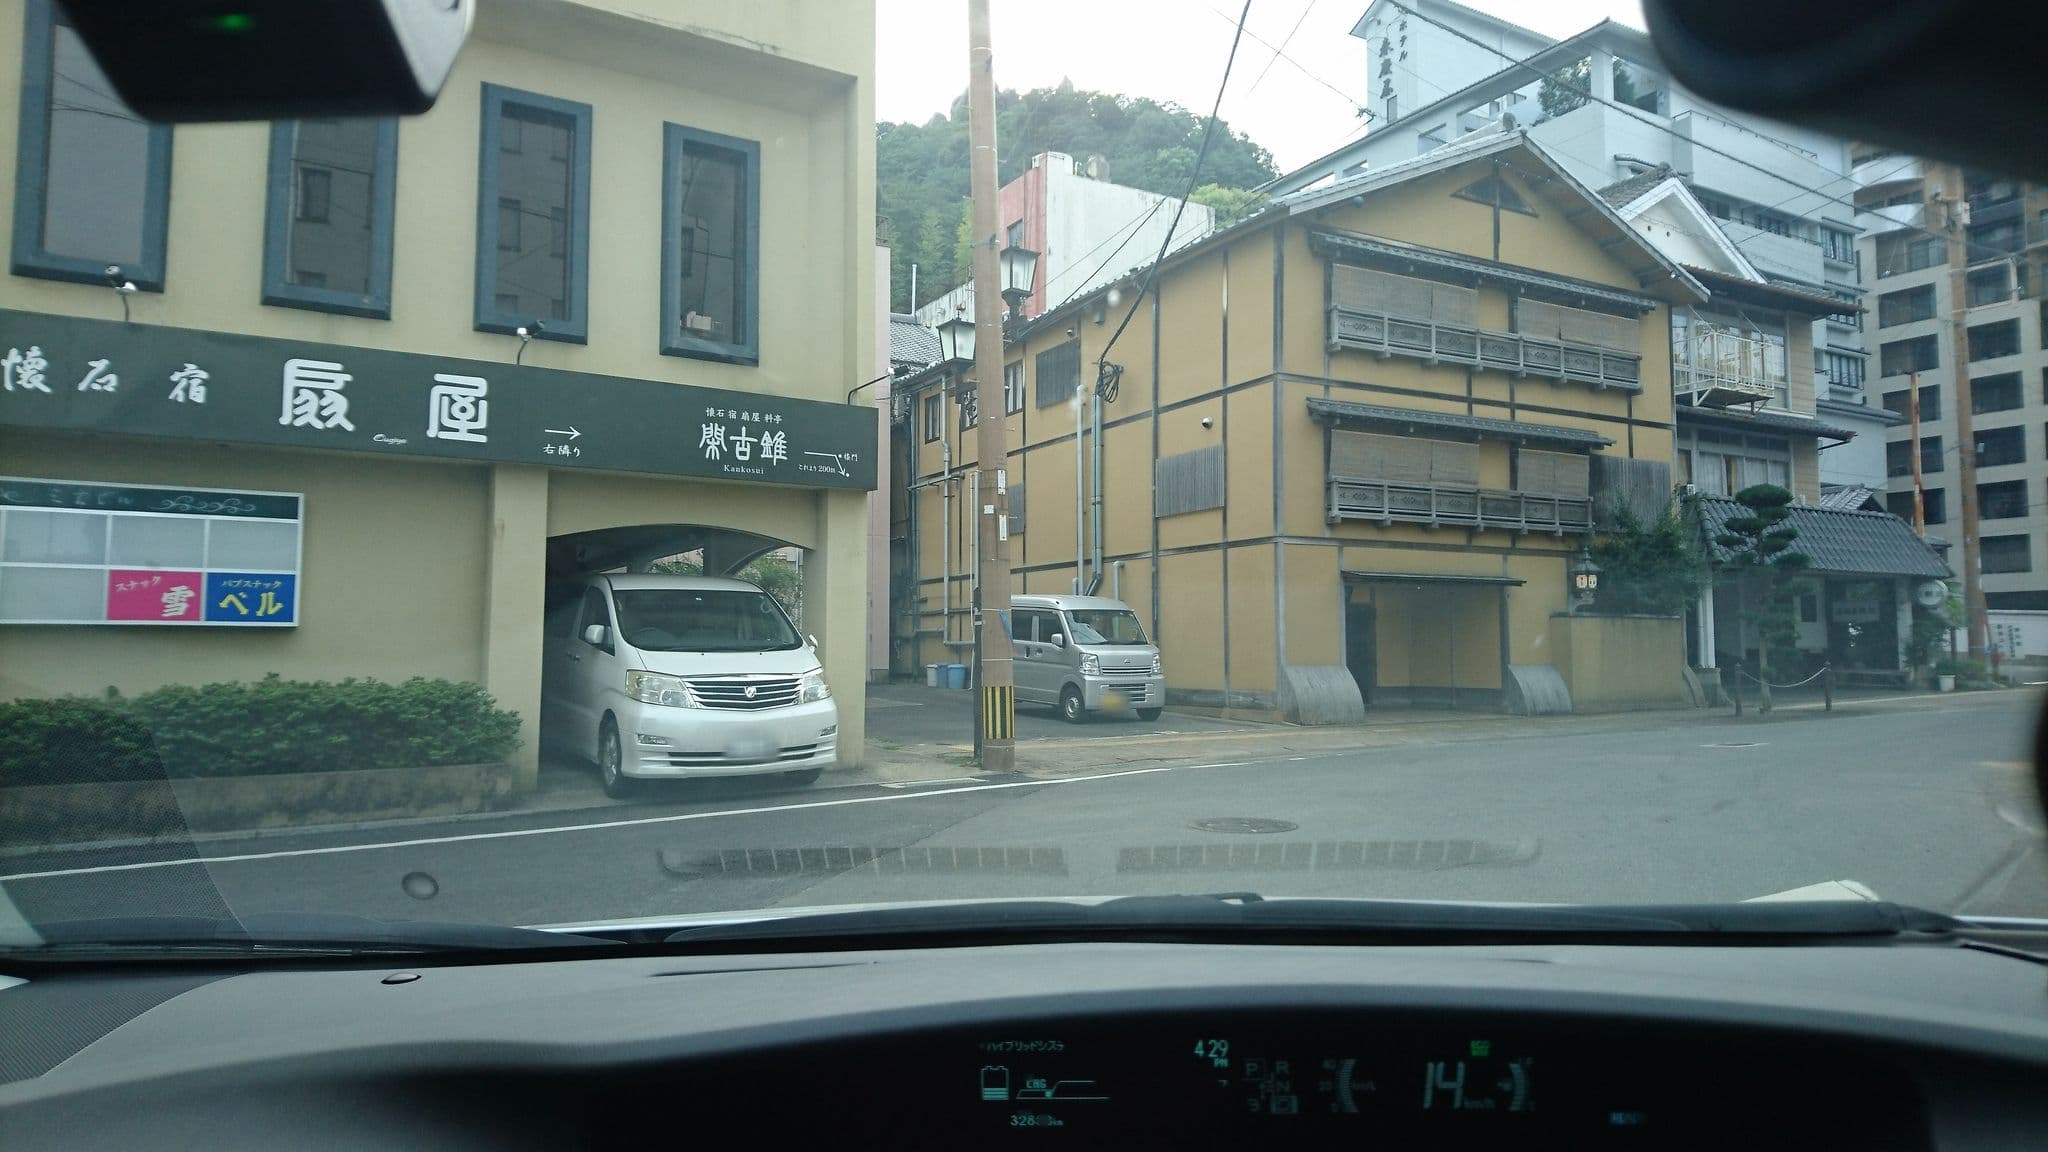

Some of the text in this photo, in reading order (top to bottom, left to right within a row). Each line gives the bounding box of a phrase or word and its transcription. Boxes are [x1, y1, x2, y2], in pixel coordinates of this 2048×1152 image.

[542, 443, 581, 457] 右隣り
[723, 464, 764, 475] Kankosui
[115, 576, 161, 592] スナック
[220, 579, 282, 589] パブスナック
[160, 585, 196, 617] 雪
[218, 590, 285, 617] ベル
[1421, 1060, 1465, 1110] 14
